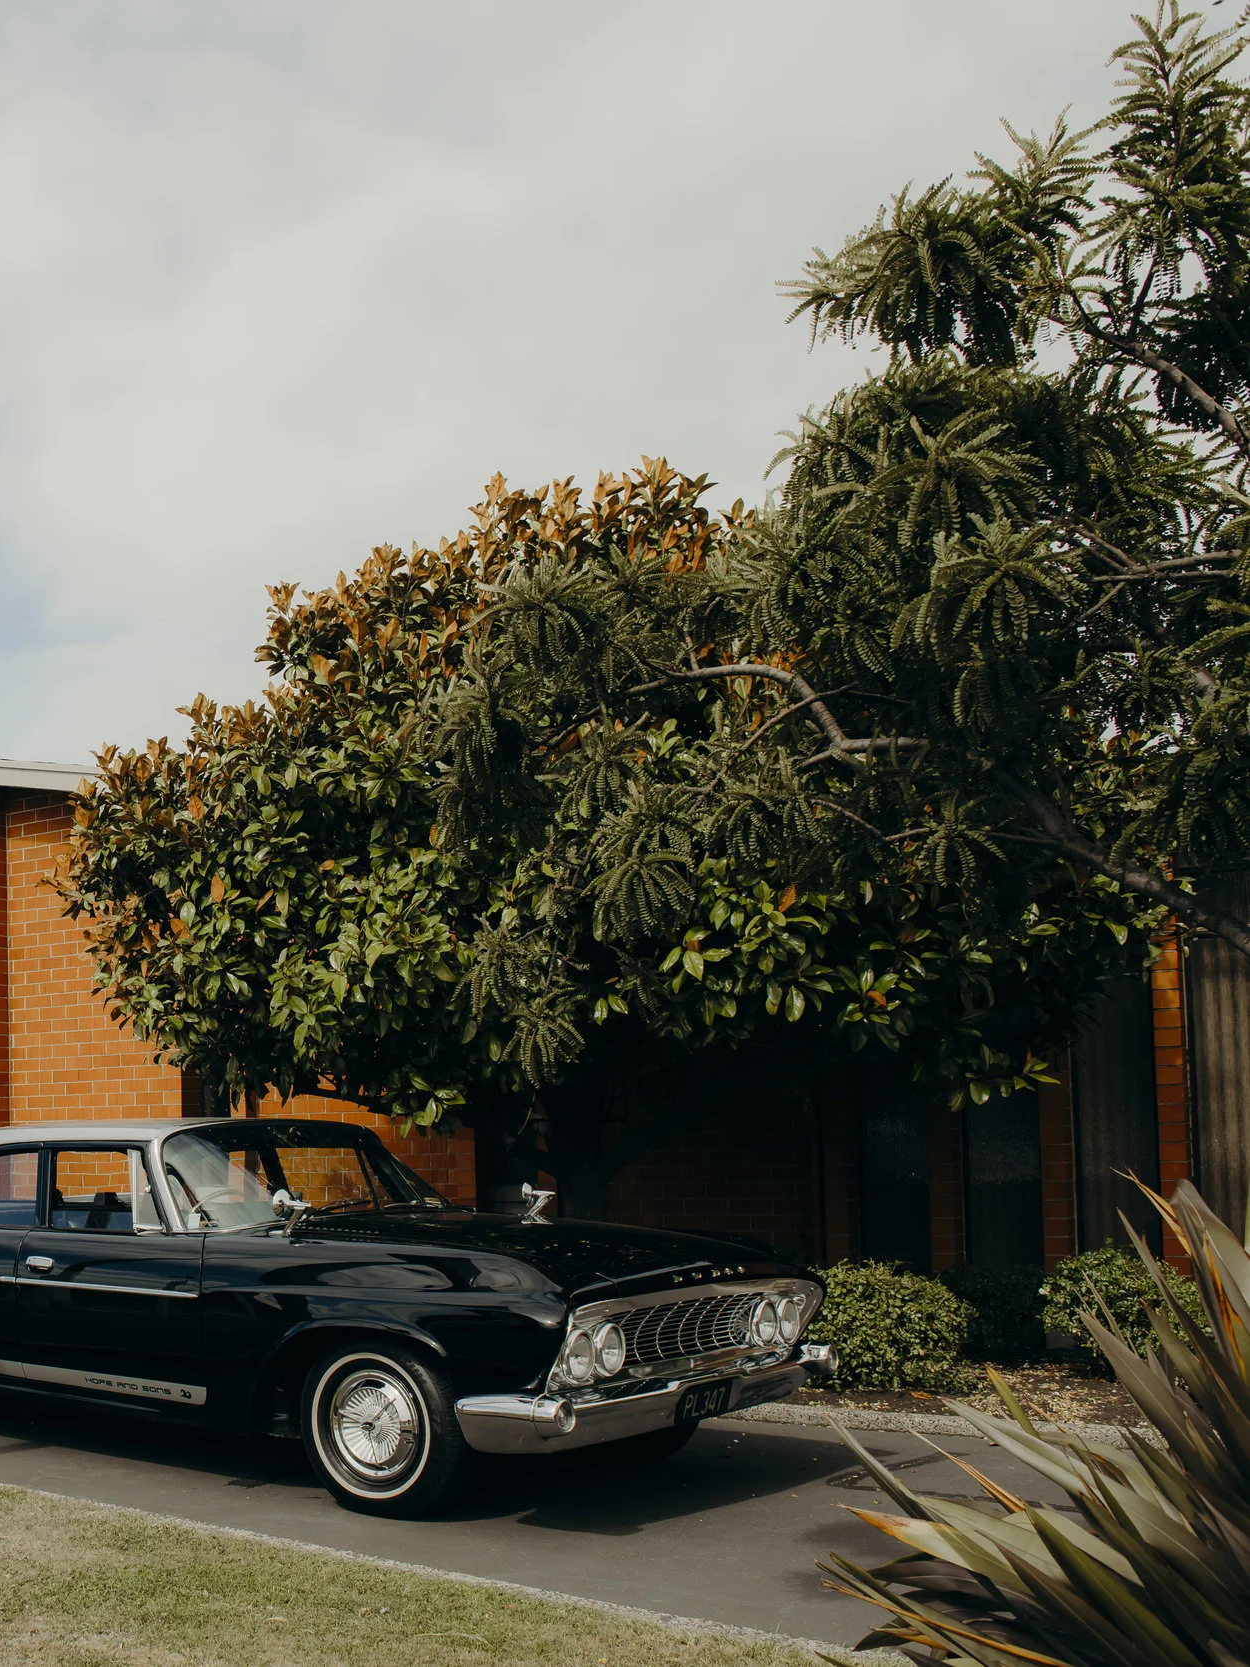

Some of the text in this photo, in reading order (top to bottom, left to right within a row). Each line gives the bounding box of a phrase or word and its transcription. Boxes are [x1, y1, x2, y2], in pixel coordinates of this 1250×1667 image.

[85, 1376, 113, 1387] HOPE
[142, 1385, 172, 1395] SONS
[682, 1387, 727, 1419] PL347
